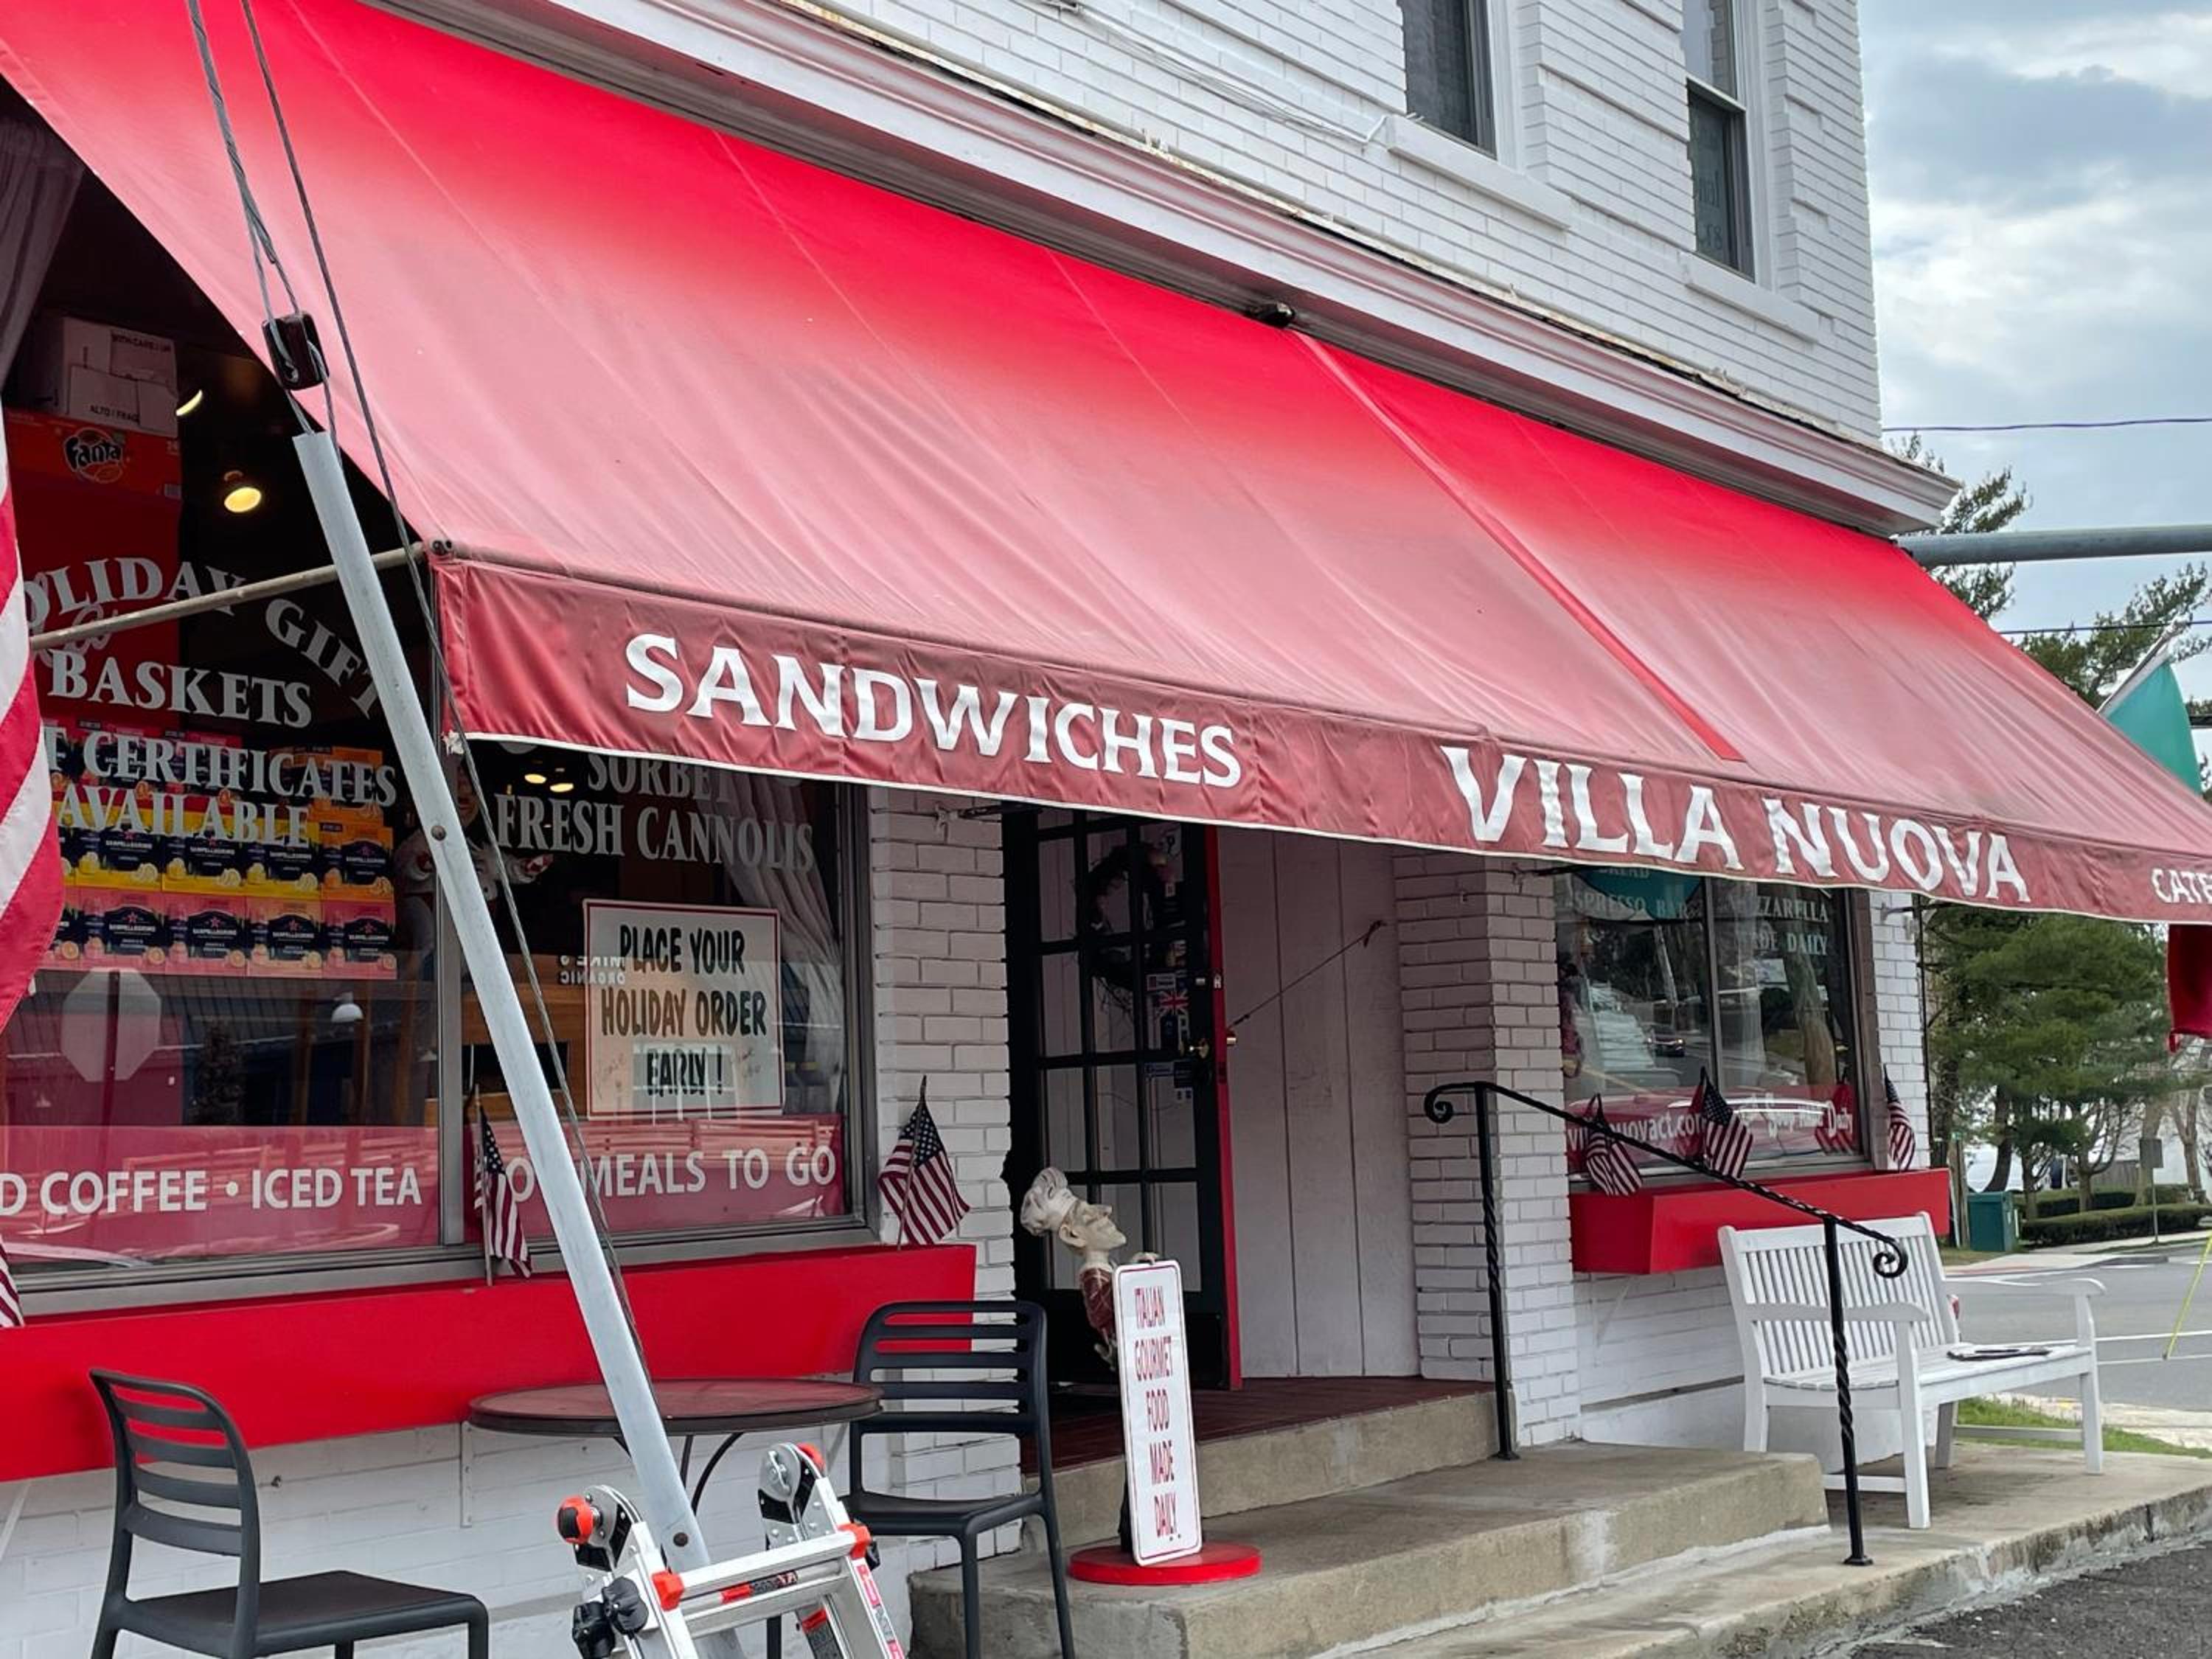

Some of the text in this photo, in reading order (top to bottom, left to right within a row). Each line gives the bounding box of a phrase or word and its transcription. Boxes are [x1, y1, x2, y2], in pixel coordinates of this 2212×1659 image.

[65, 436, 123, 471] Fanta
[24, 557, 246, 629] OLIDAY
[47, 648, 312, 728] BASKETS
[624, 633, 1242, 790] SANDWICHES
[82, 730, 397, 807] CERTIFICATES
[58, 782, 311, 849] AVAILABLE
[495, 793, 814, 874] FRESH CANNOLIS
[1440, 745, 2031, 903] VILLA NUOVA
[619, 924, 746, 975] PLACE YOUR
[600, 986, 768, 1037] HOLIDAY ORDER
[40, 1170, 208, 1215] COFFEE
[251, 1168, 344, 1209] ICED
[351, 1167, 422, 1206] TEA
[723, 1147, 770, 1191] TO
[786, 1144, 836, 1188] GO
[1134, 1286, 1166, 1329] ITALIAN
[1134, 1335, 1172, 1381] GOURMET
[1146, 1388, 1170, 1432] FOOD
[1150, 1440, 1175, 1485] MADE
